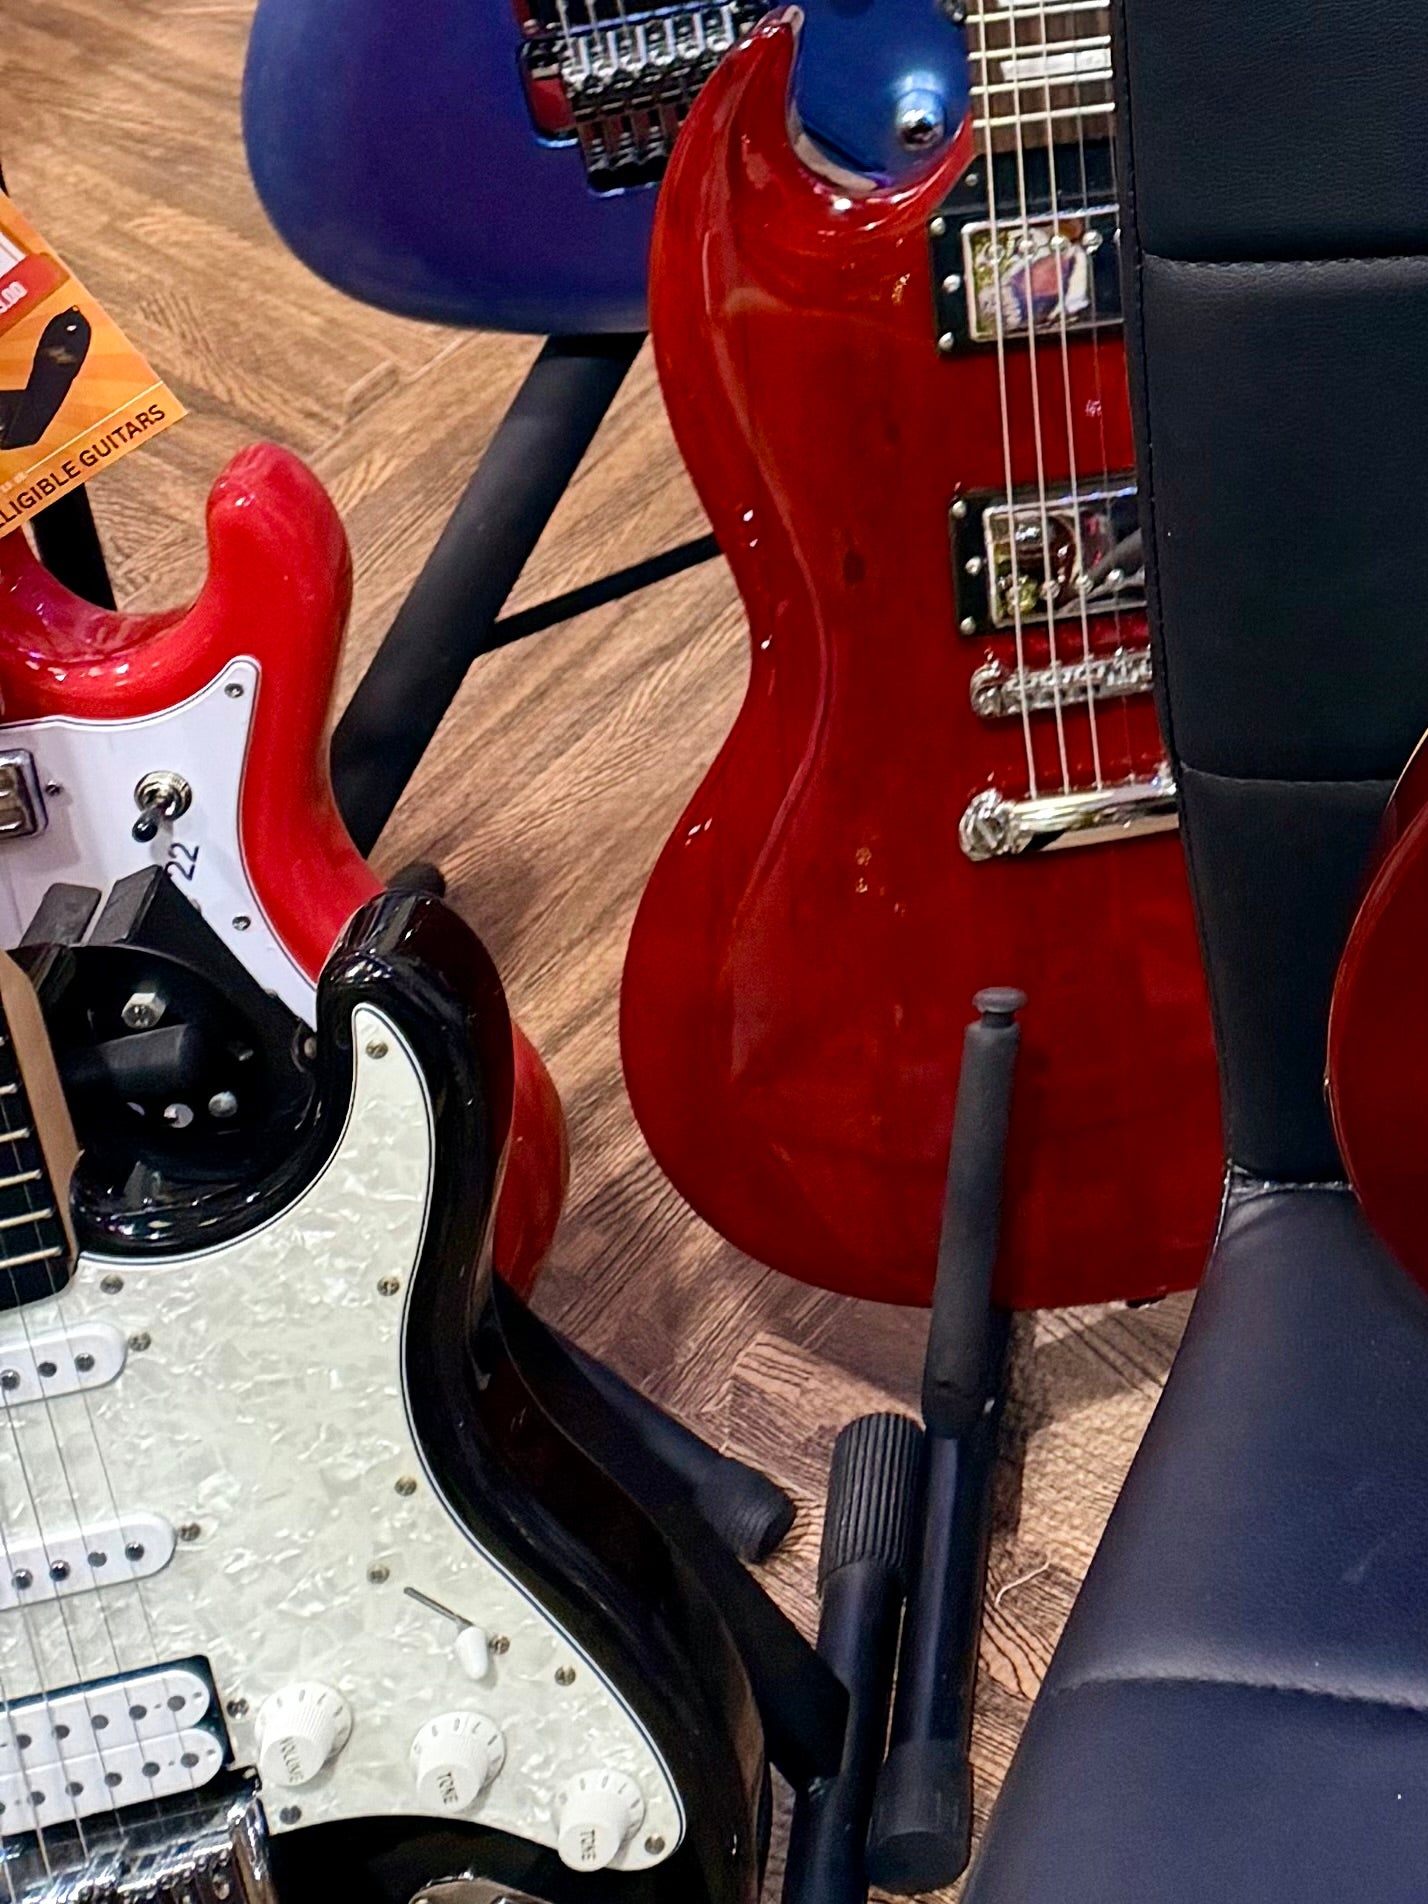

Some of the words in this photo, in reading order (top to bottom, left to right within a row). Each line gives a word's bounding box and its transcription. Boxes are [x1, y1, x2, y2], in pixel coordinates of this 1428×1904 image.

[0, 459, 81, 529] LIGIBLE
[78, 403, 167, 469] GUITARS
[436, 1771, 458, 1806] TONE
[579, 1828, 597, 1862] TONE
